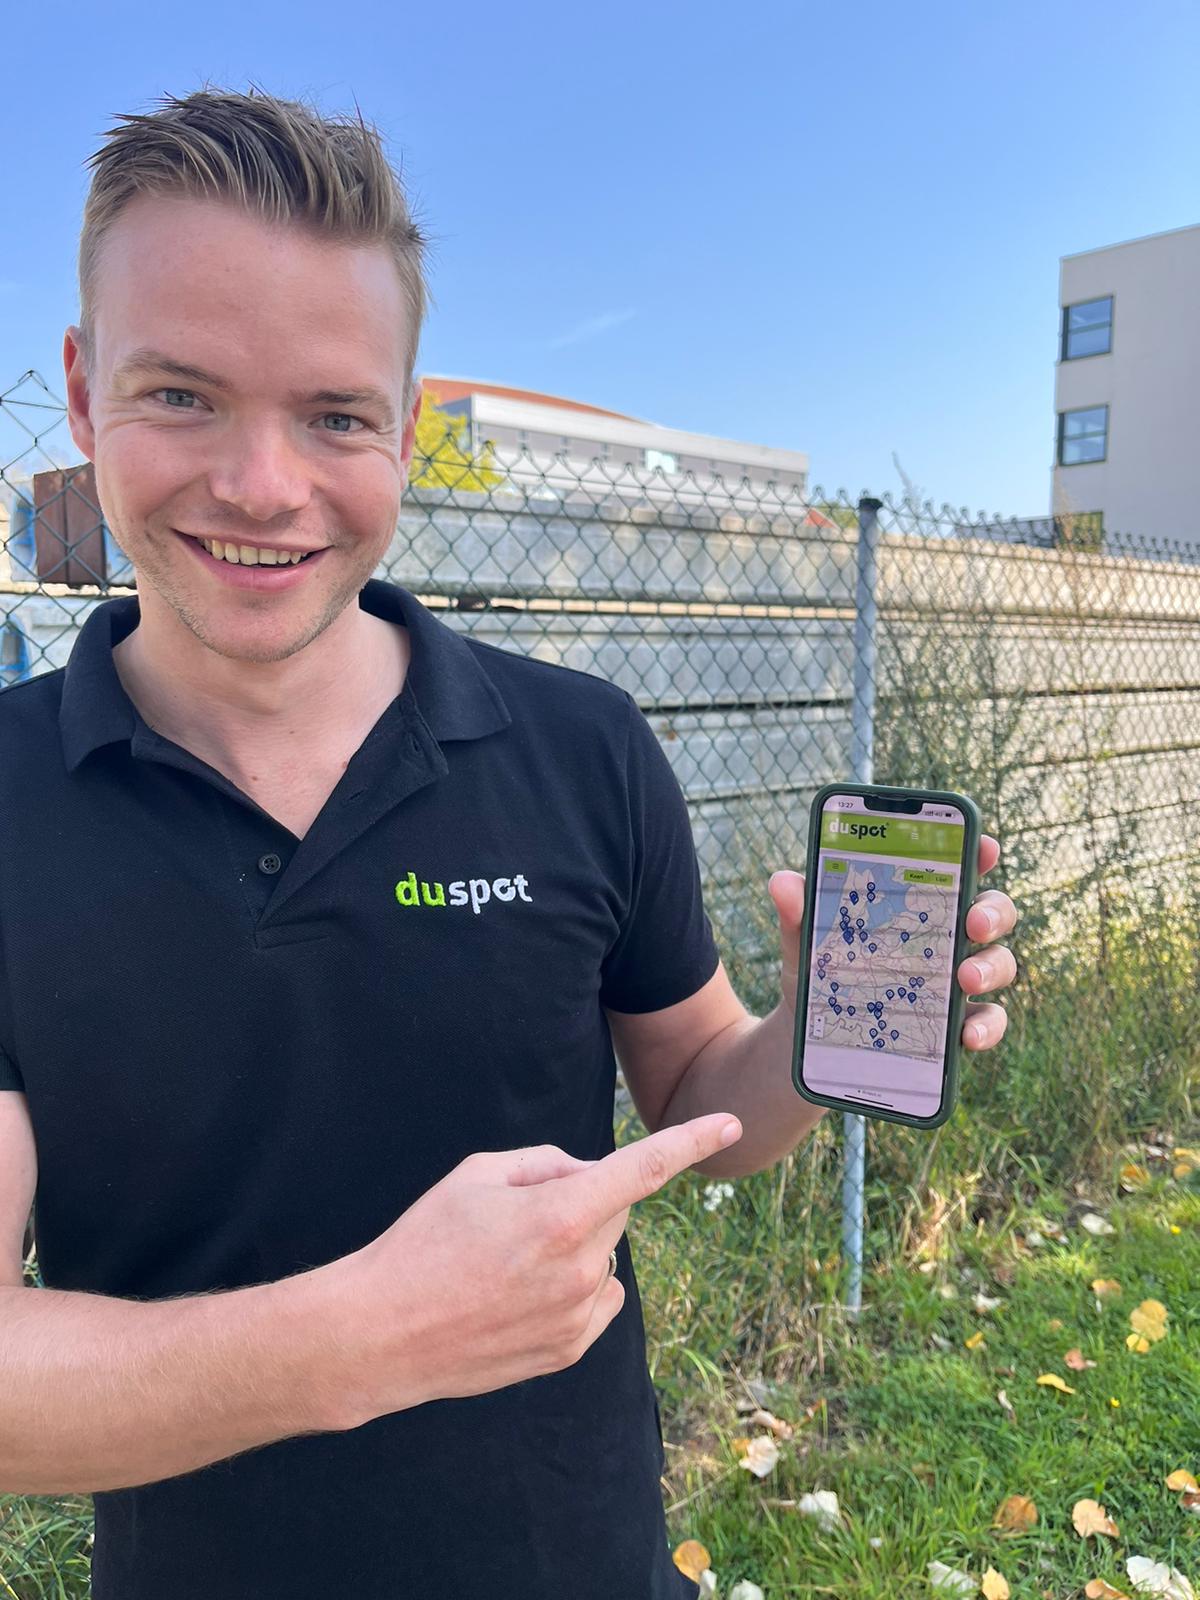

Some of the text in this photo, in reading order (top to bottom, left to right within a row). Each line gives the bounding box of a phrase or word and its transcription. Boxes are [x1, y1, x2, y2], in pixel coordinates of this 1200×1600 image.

[838, 801, 854, 809] 13:27
[829, 817, 888, 840] duspot
[394, 871, 534, 915] duspot
